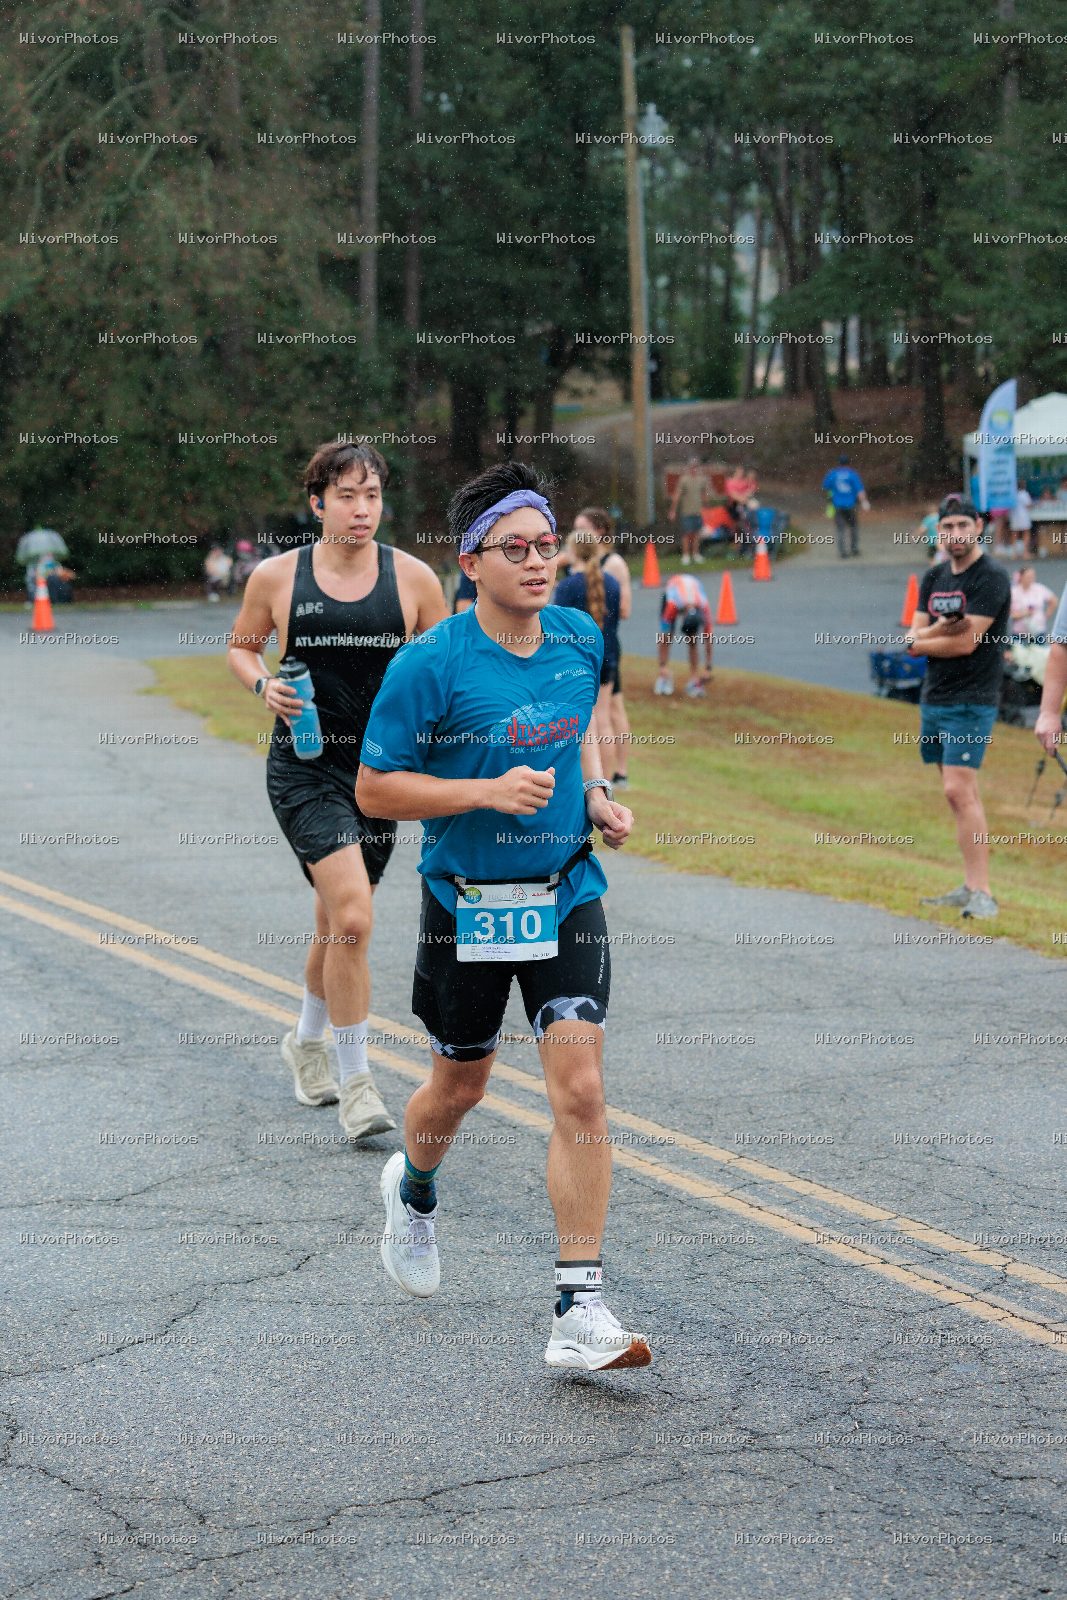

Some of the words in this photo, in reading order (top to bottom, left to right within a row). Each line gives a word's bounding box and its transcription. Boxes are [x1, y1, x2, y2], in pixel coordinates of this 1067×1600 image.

[519, 714, 579, 738] TUCSON
[530, 744, 549, 753] HALF
[473, 909, 542, 940] 310
